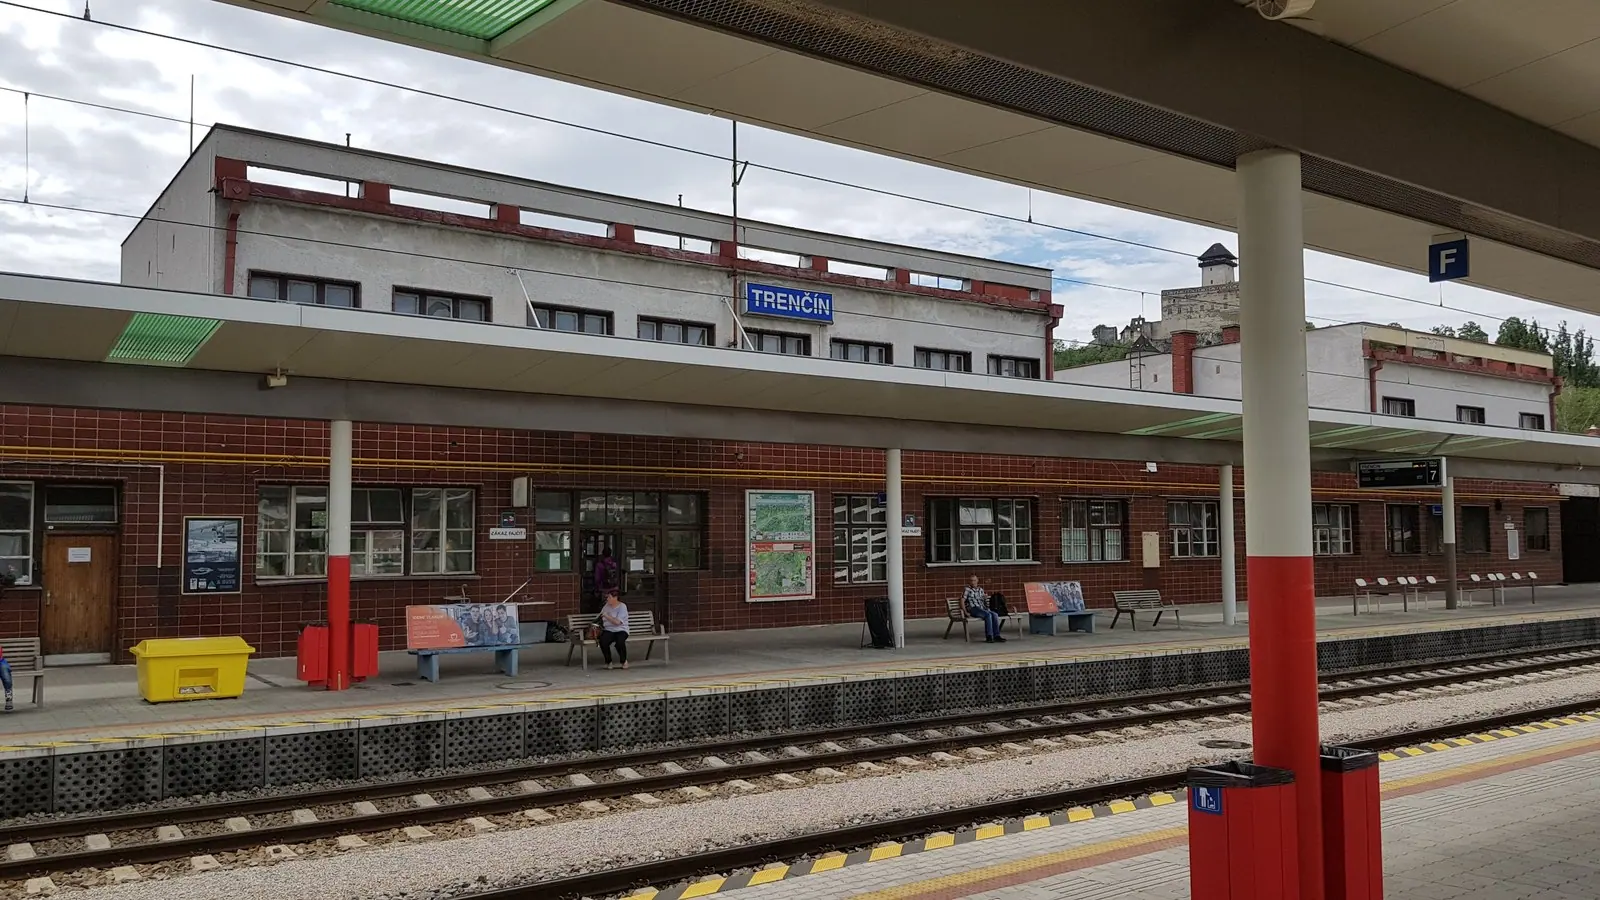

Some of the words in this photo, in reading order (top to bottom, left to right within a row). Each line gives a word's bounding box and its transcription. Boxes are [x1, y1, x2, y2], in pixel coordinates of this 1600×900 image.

[1440, 248, 1457, 274] F
[751, 289, 830, 316] TRENČÍN
[1430, 470, 1437, 481] 7
